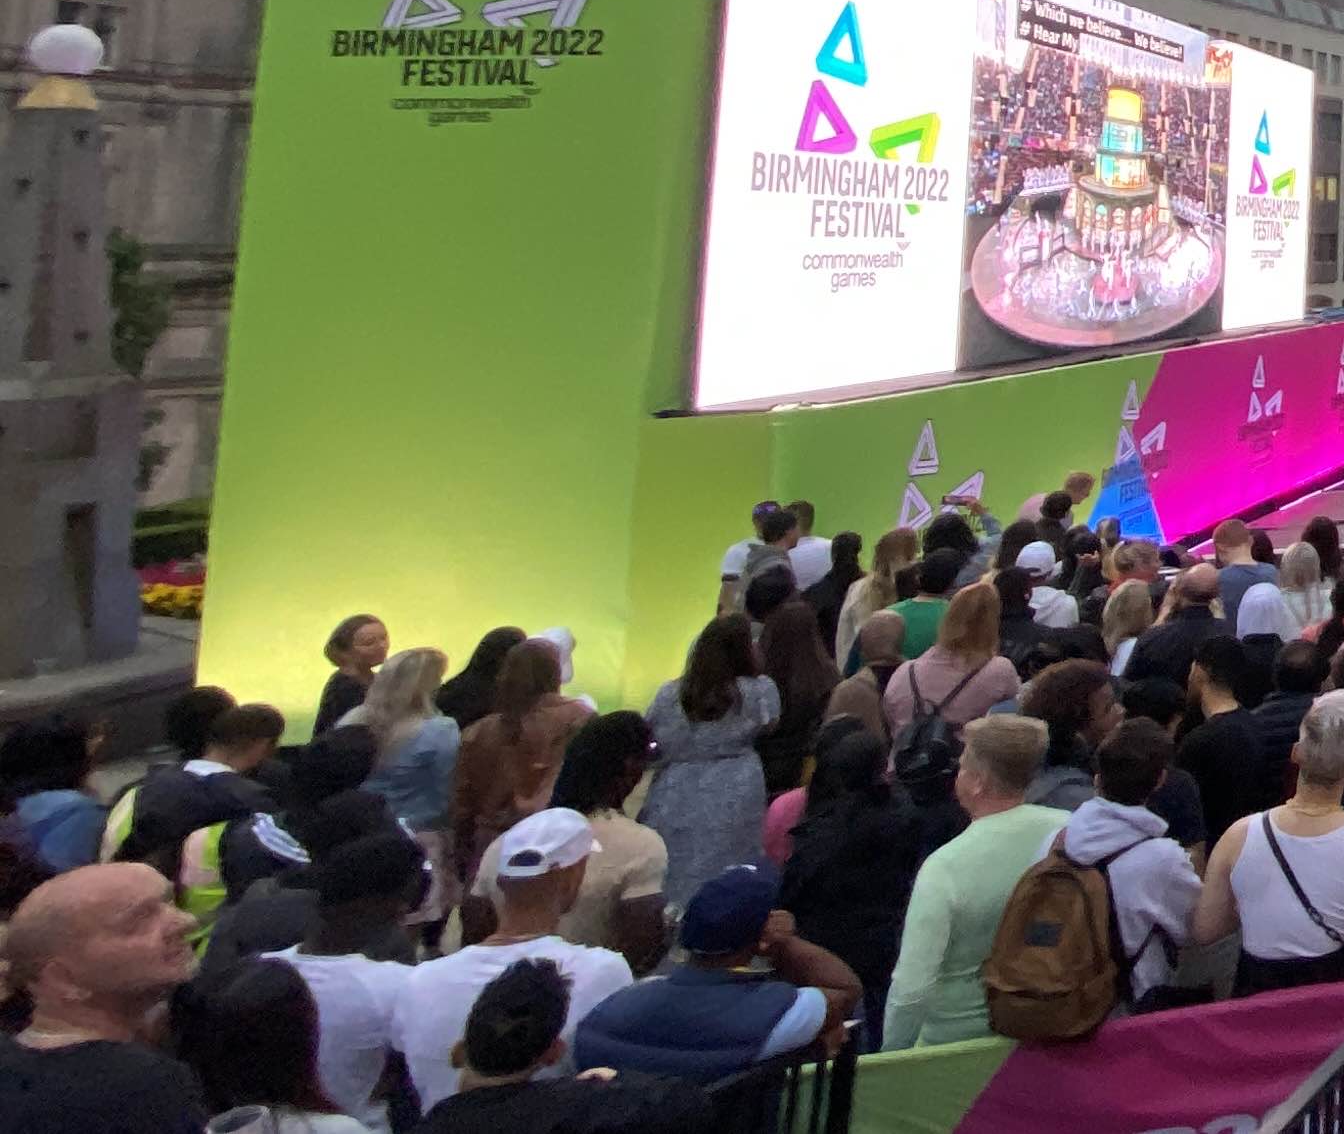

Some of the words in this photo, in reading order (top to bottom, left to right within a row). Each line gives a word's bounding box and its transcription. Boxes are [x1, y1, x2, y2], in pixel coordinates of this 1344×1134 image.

[1033, 24, 1060, 45] Hear
[1062, 32, 1079, 53] My
[1034, 0, 1067, 24] Which
[1069, 14, 1085, 29] we
[1134, 32, 1150, 49] We
[331, 30, 523, 57] BIRMINGHAM
[529, 30, 604, 56] 2022
[401, 58, 534, 87] FESTIVAL
[751, 151, 899, 199] BIRMINGHAM
[903, 165, 949, 202] 2022
[811, 199, 905, 238] FESTIVAL
[1235, 194, 1282, 218] BIRMINGHAM
[1283, 200, 1300, 220] 2022
[1253, 220, 1285, 241] FESTIVAL
[802, 251, 904, 271] commonwealth
[830, 270, 877, 294] games
